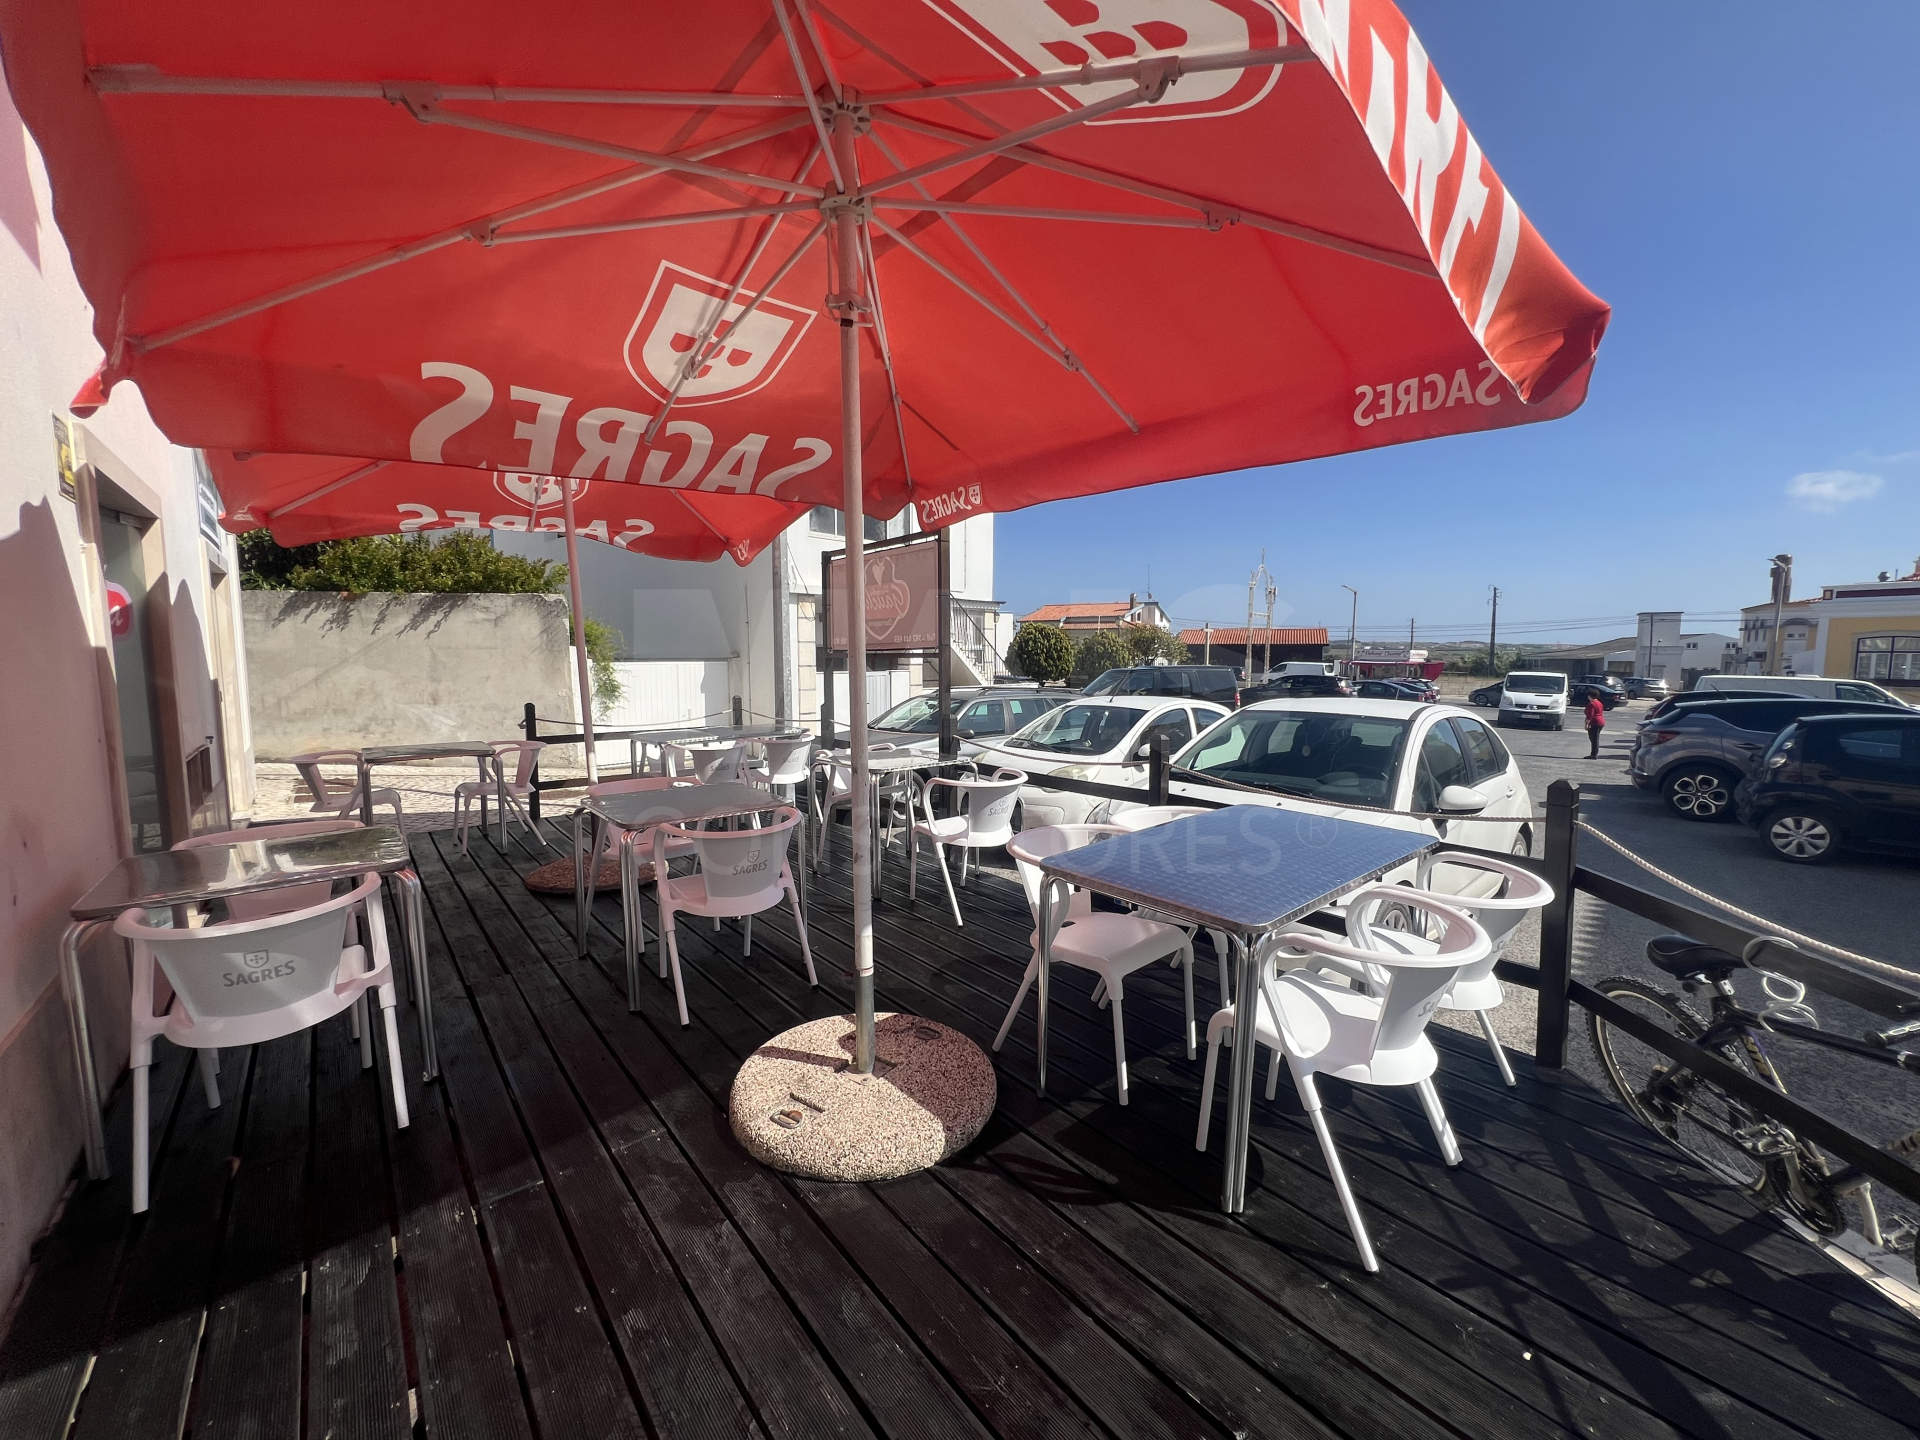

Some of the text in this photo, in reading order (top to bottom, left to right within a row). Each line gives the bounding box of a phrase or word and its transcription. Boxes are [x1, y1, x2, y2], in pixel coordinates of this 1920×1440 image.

[987, 804, 1010, 817] SAGRES
[731, 859, 769, 876] SAGRES
[222, 960, 297, 987] SAGRES
